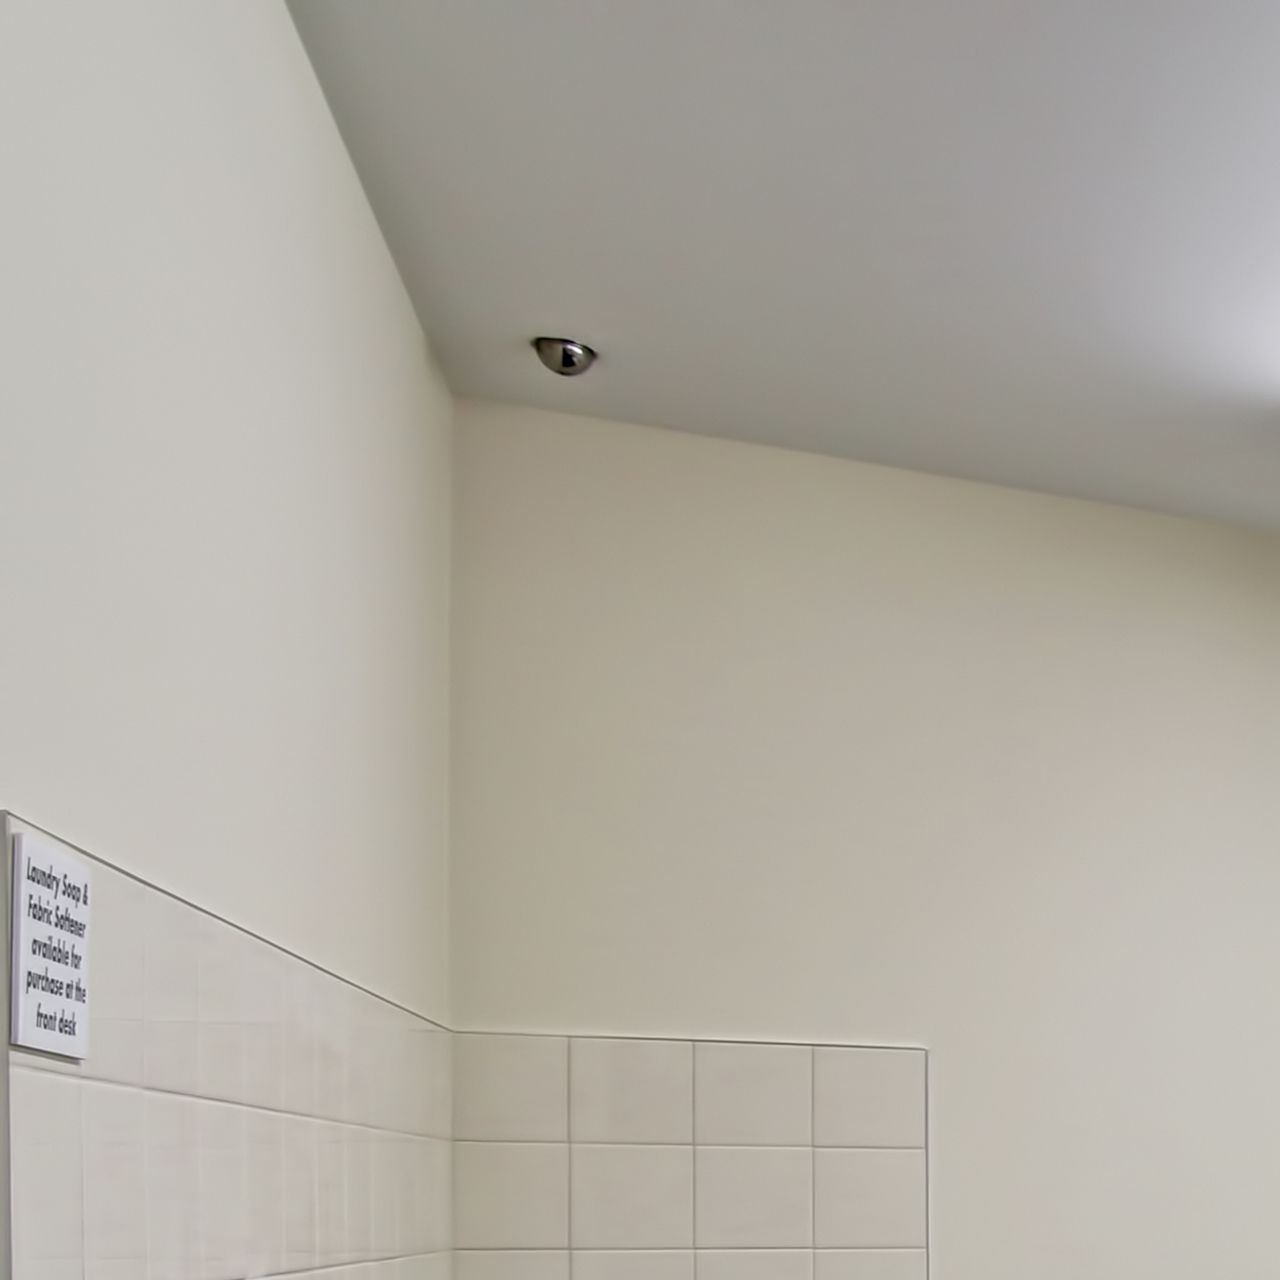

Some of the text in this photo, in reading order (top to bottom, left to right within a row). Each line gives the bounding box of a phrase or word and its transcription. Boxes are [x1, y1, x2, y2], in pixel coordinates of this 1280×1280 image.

[27, 856, 88, 908] Laundry Soap &
[27, 894, 86, 938] Fabric Softener
[31, 935, 82, 969] available for
[26, 966, 86, 1003] purchase at the
[36, 1002, 77, 1036] front desk
